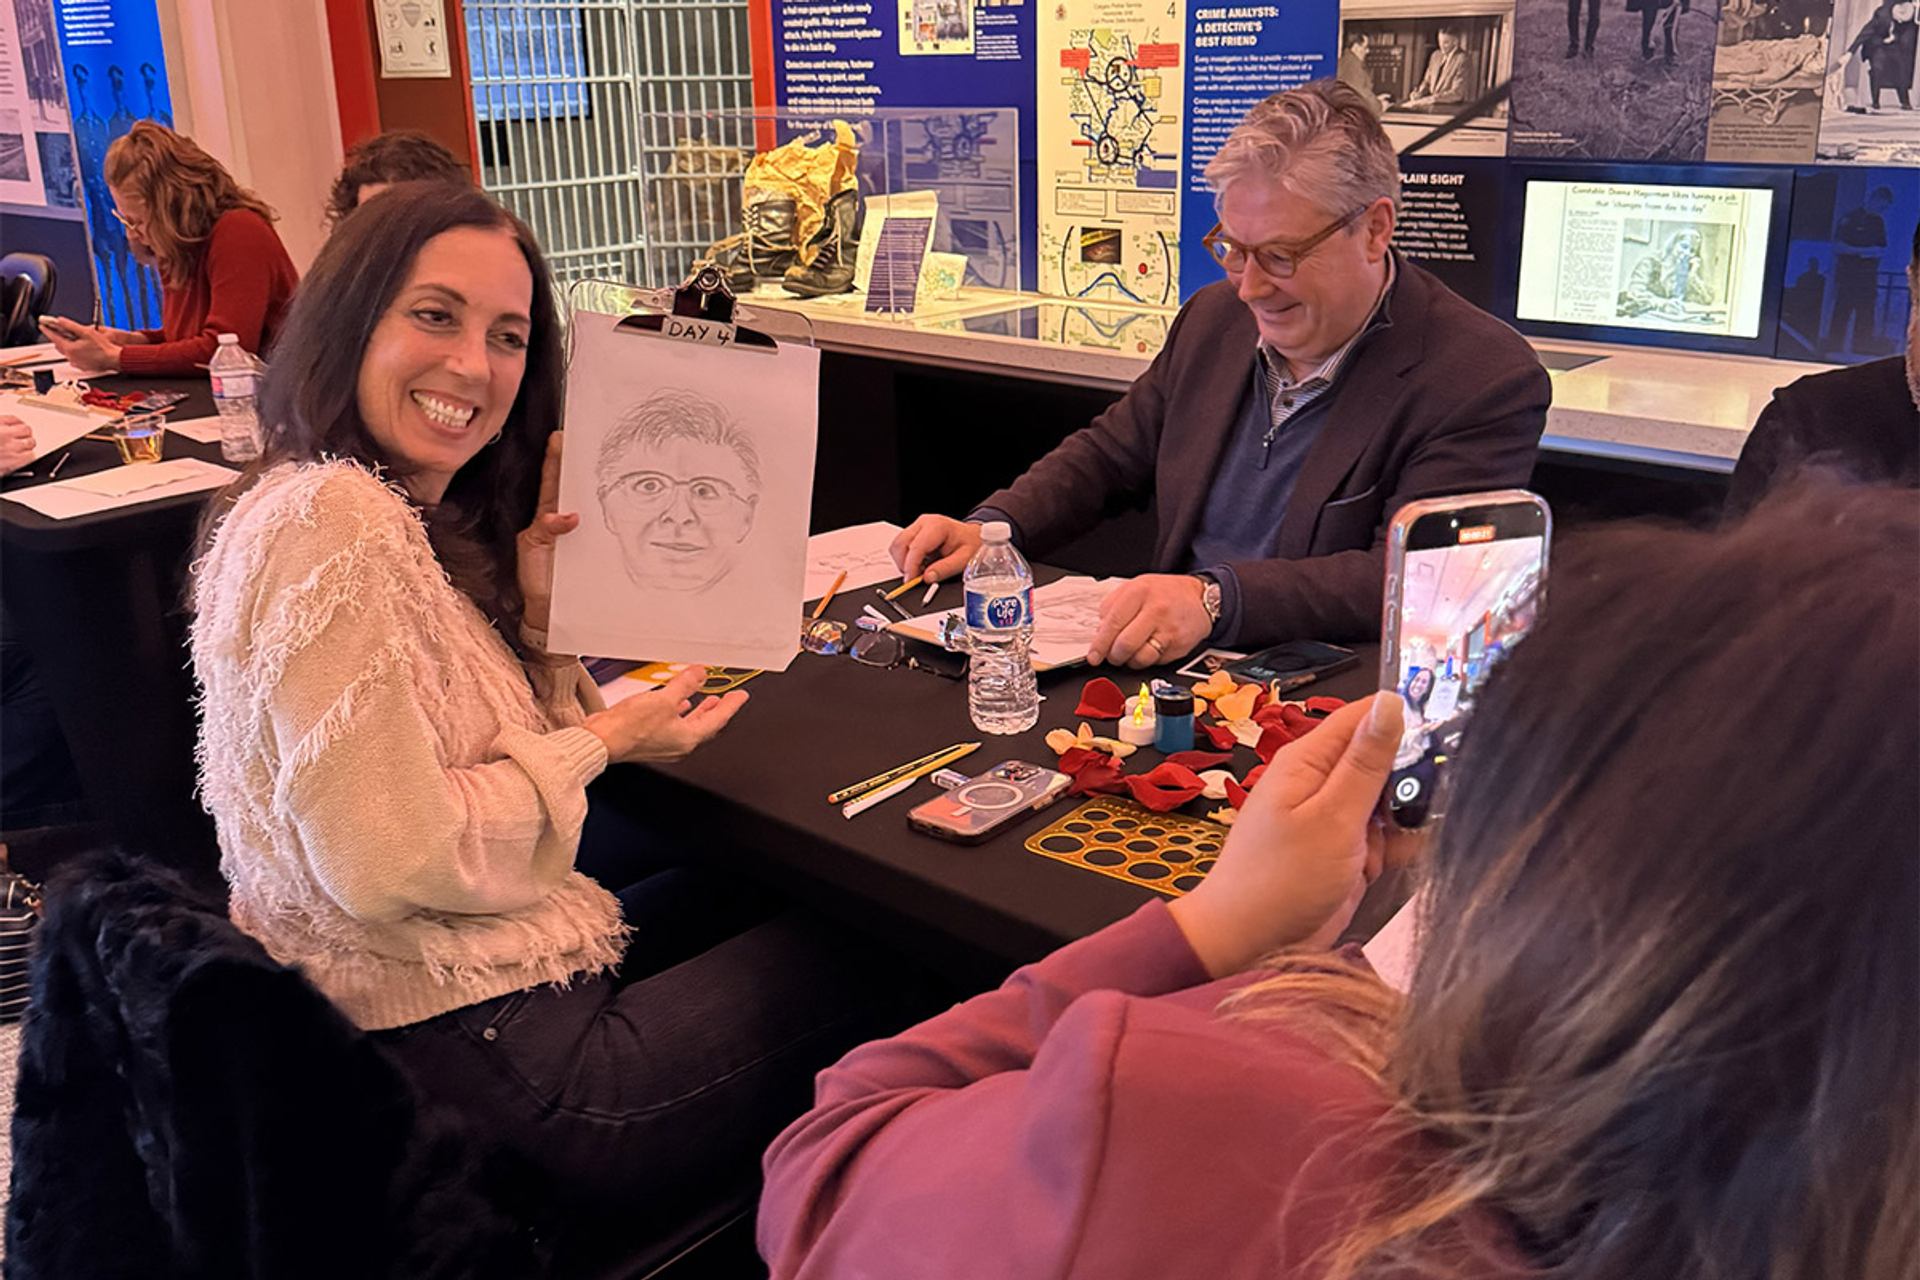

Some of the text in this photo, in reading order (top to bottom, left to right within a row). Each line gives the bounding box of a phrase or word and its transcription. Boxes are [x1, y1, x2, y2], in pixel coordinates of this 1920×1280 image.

[1166, 2, 1176, 19] 4
[1196, 6, 1279, 20] CRIME ANALYSTS:
[1195, 21, 1263, 33] A DETECTIVE'S
[1195, 35, 1257, 47] BEST FRIEND
[1430, 174, 1465, 185] SIGHT
[668, 321, 731, 346] DAY 4
